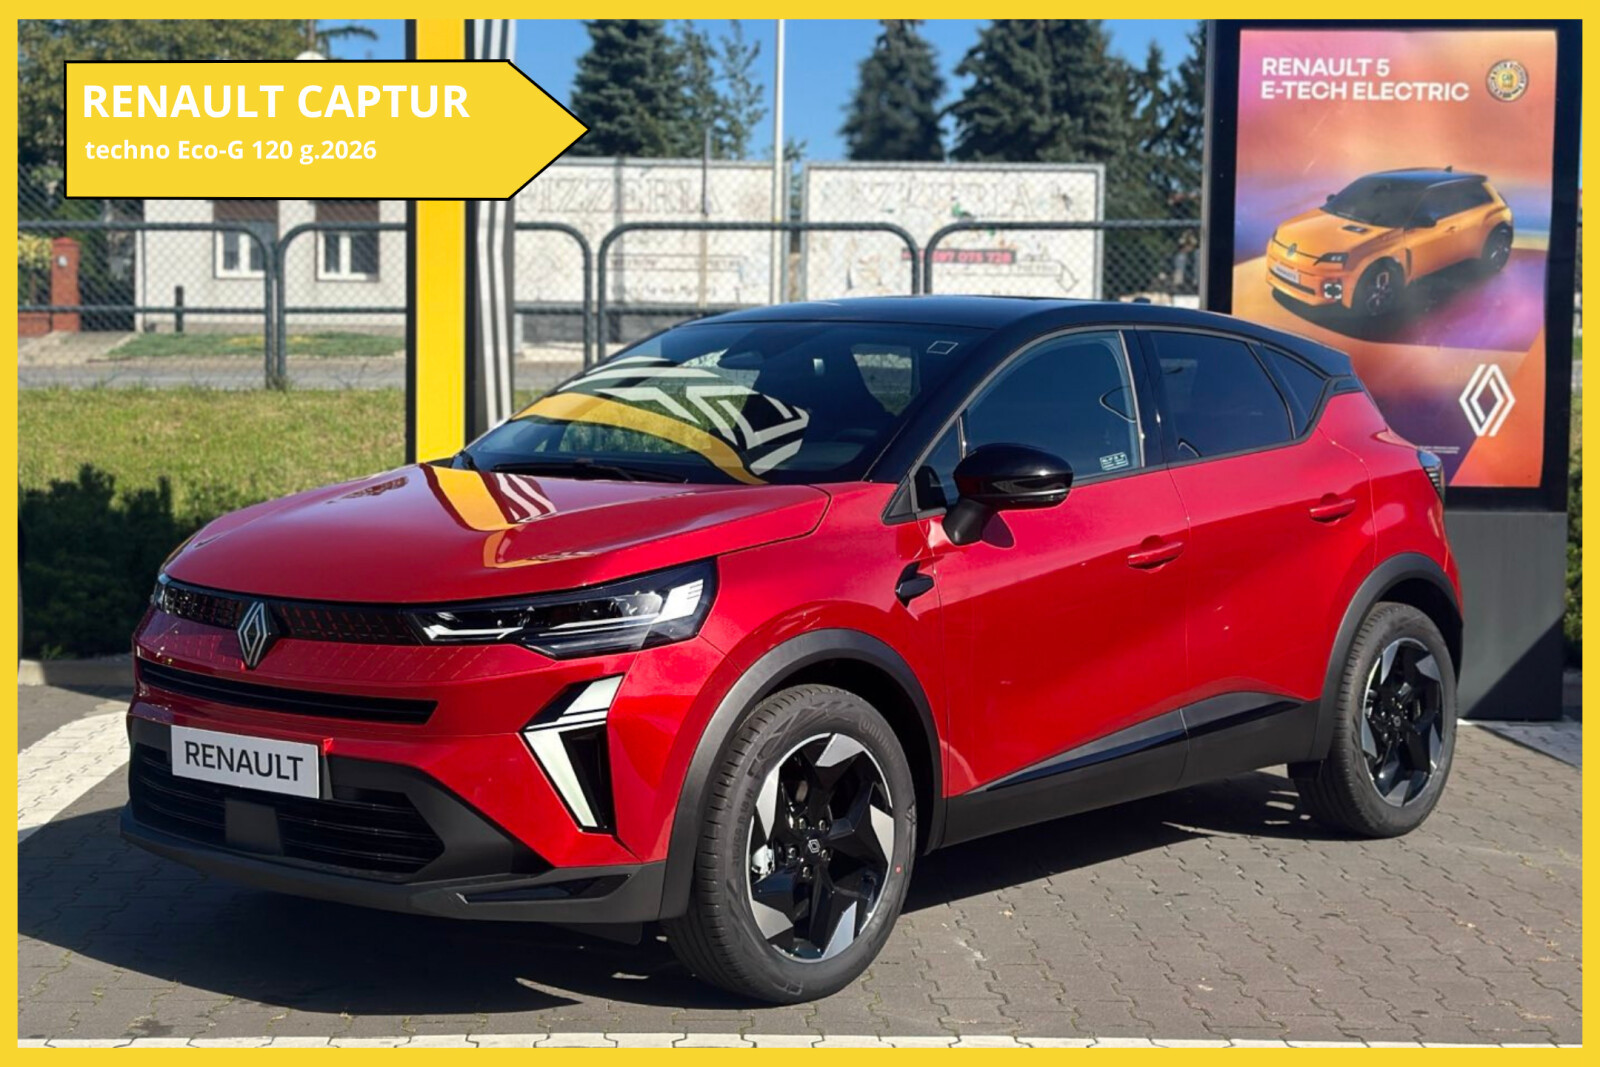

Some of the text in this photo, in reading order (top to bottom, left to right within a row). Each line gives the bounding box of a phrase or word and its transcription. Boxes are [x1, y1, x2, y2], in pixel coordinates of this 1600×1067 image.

[1262, 57, 1390, 77] RENAULT 5
[1261, 80, 1348, 100] E-TECH
[1352, 81, 1469, 101] ELECTRIC
[184, 740, 304, 782] RENAULT
